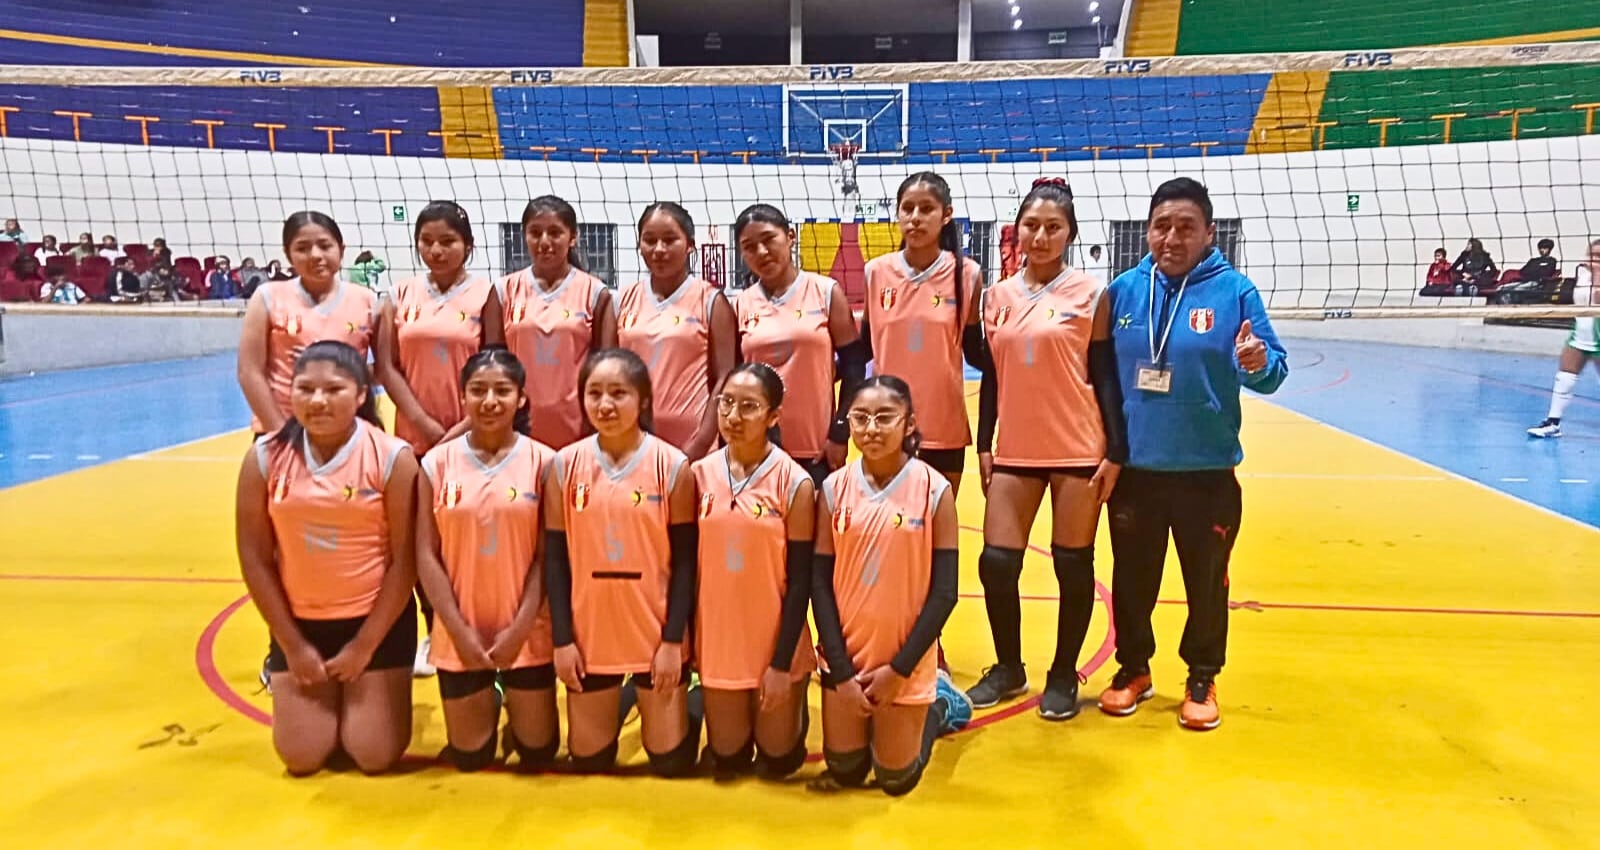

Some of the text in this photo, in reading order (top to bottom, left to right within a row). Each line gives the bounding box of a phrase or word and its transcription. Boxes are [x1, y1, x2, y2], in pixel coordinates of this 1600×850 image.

[240, 70, 281, 83] FIVB
[511, 70, 553, 83] FIVB
[810, 65, 854, 80] FIVB
